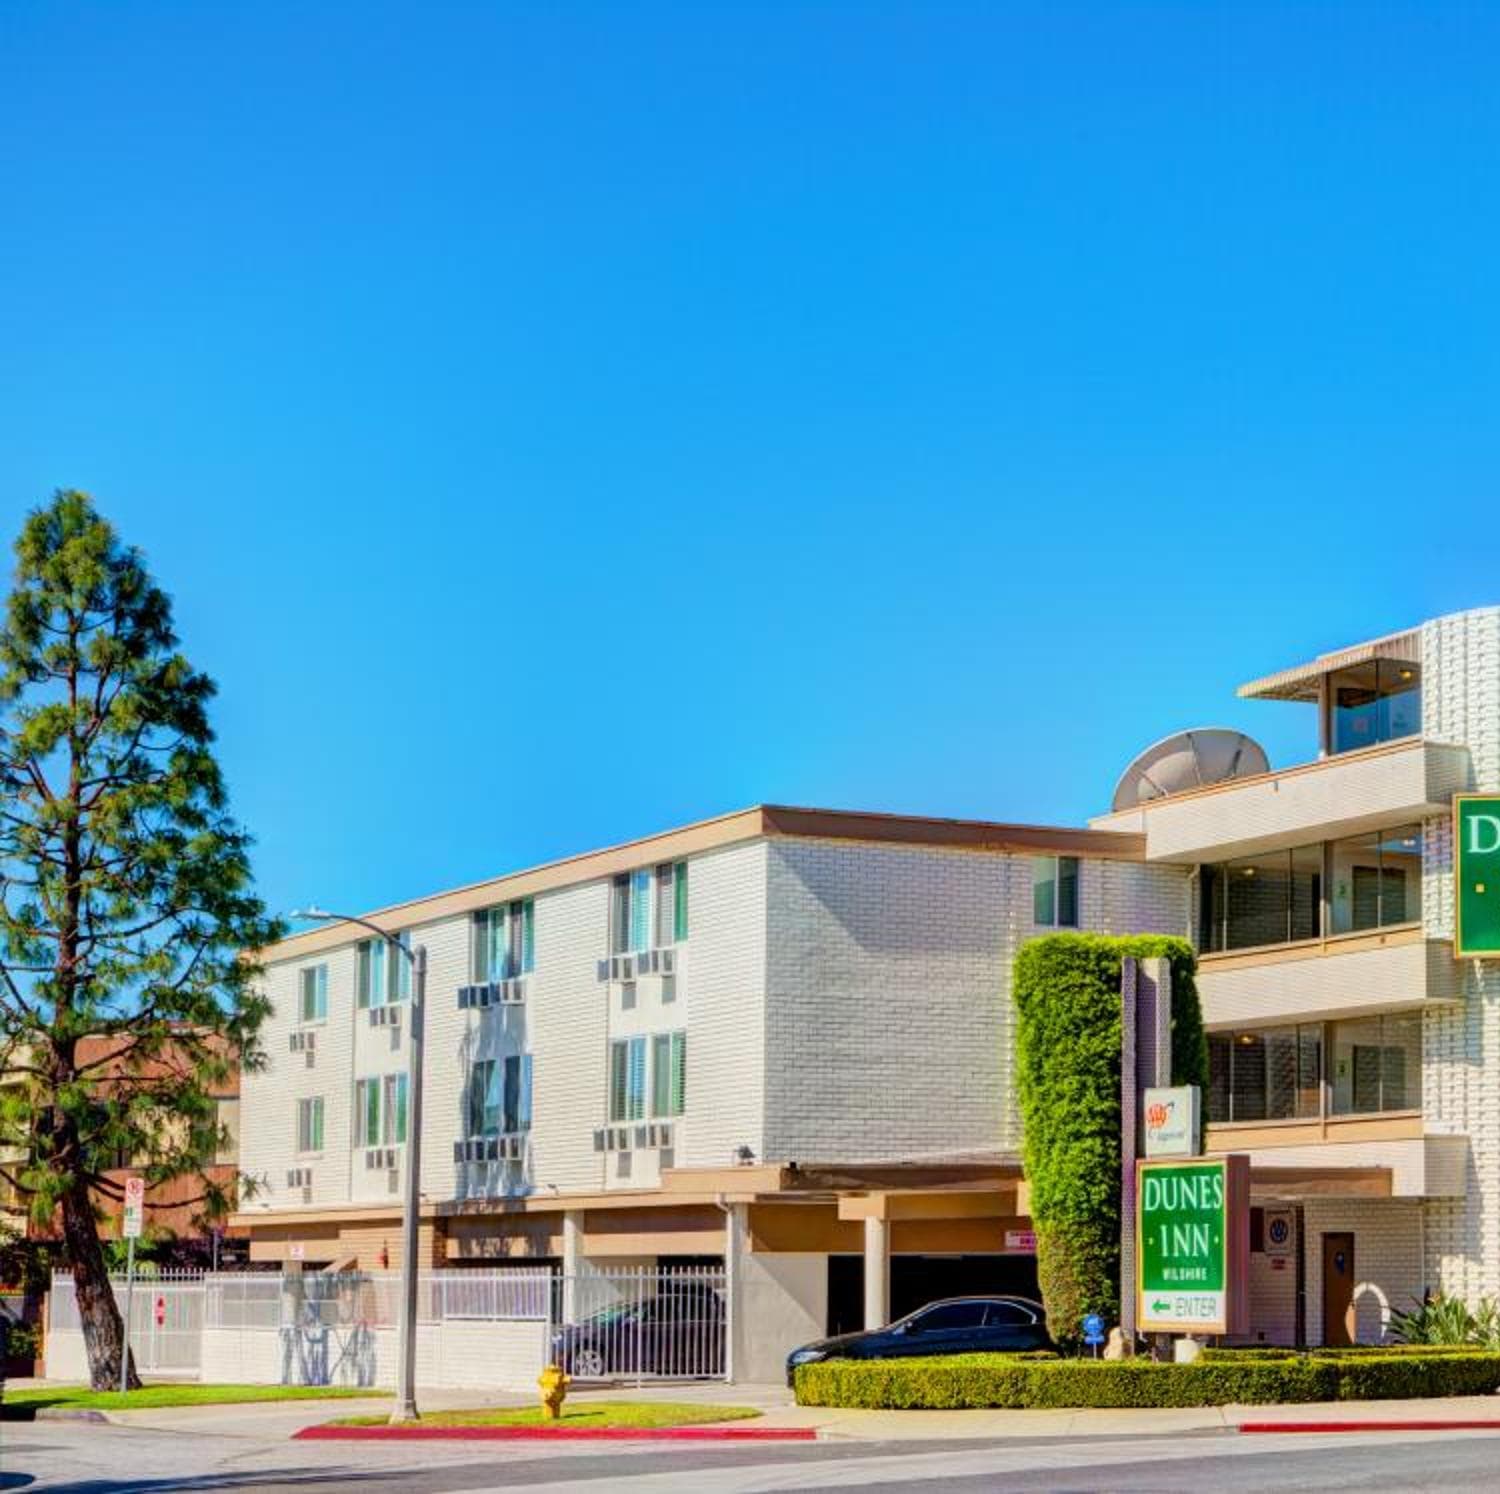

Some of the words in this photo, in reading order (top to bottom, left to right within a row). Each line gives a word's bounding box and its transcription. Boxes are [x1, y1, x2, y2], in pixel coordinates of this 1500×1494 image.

[1144, 1174, 1223, 1211] DUNES
[1160, 1224, 1210, 1257] INN
[1162, 1267, 1208, 1281] WILSHIRE
[1175, 1297, 1217, 1317] ENTER
